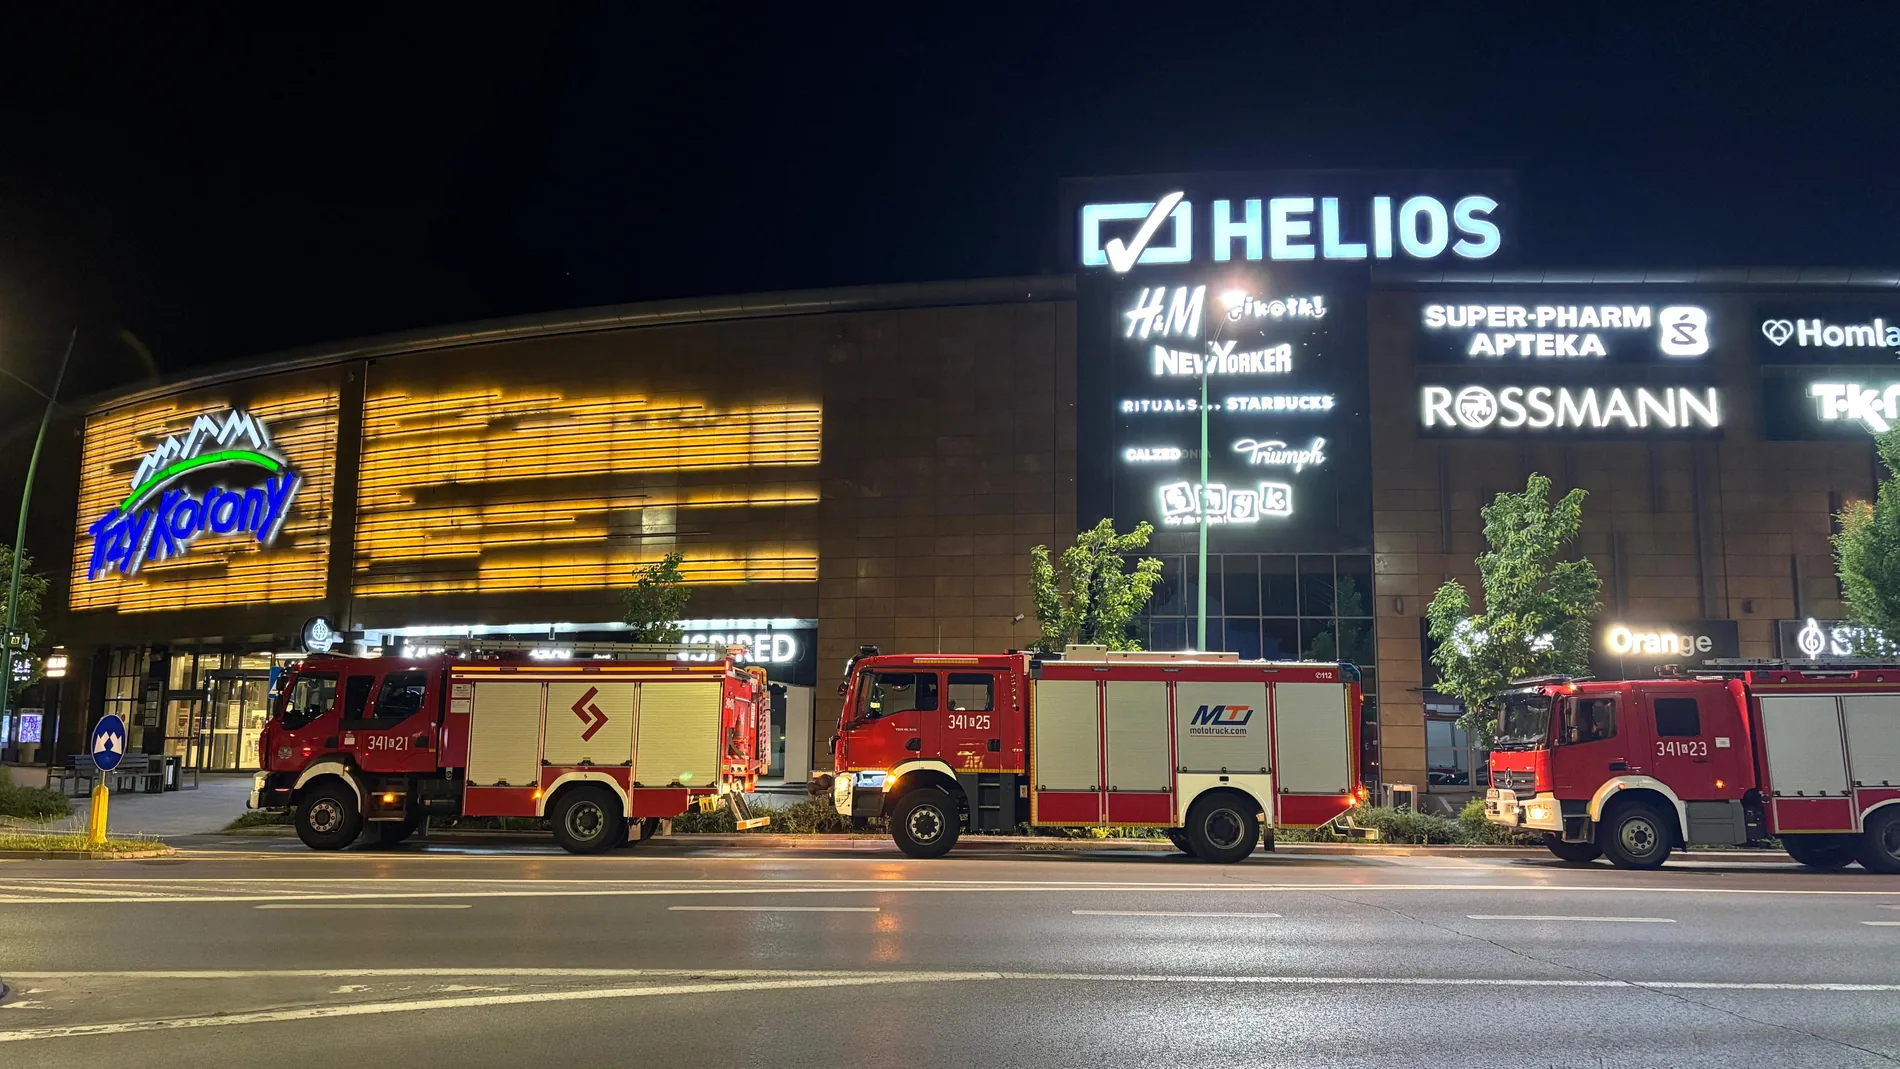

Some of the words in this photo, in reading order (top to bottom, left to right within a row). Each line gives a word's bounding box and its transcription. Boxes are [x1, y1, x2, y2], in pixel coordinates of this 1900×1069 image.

[1214, 196, 1500, 260] HELIOS
[1126, 285, 1206, 339] H&M
[1425, 304, 1651, 328] SUPER-PHARM
[1468, 333, 1606, 356] APTEKA
[1797, 318, 1900, 347] Homla
[1227, 396, 1334, 411] STARBUCKS
[1423, 386, 1719, 428] ROSSMANN
[1234, 437, 1326, 473] Triumph
[88, 508, 151, 581] Trzy
[148, 471, 295, 561] Korony
[1608, 628, 1713, 657] Orange
[1190, 726, 1247, 735] mototruck.com
